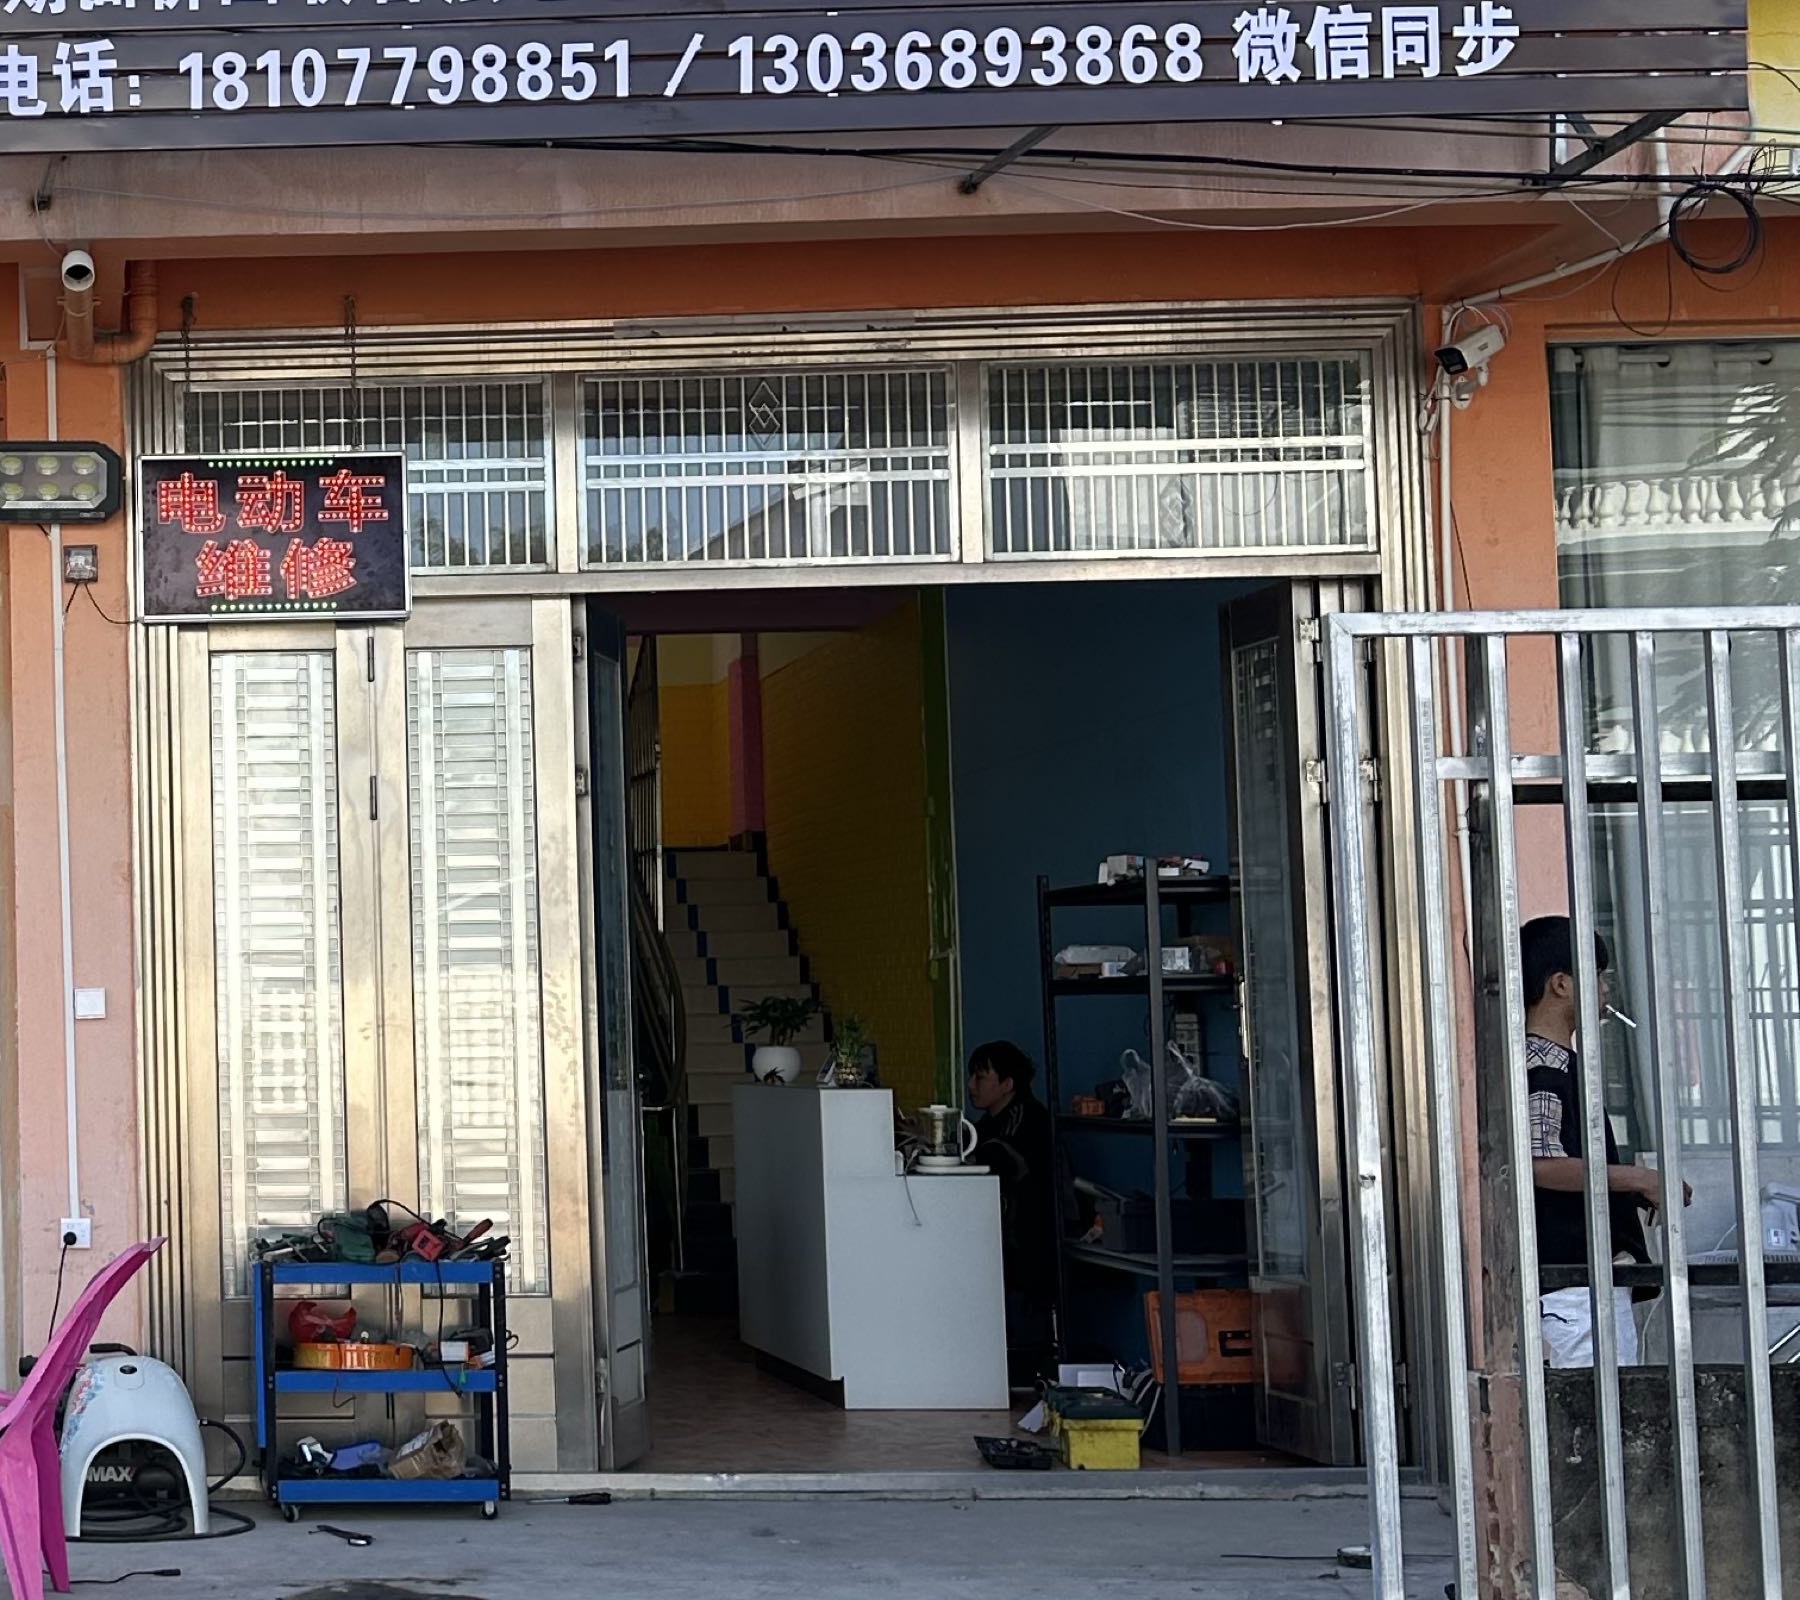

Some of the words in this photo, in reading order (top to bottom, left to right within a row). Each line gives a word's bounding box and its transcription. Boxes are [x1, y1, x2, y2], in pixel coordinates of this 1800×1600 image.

[156, 468, 389, 533] 电动车
[195, 537, 358, 600] 维修
